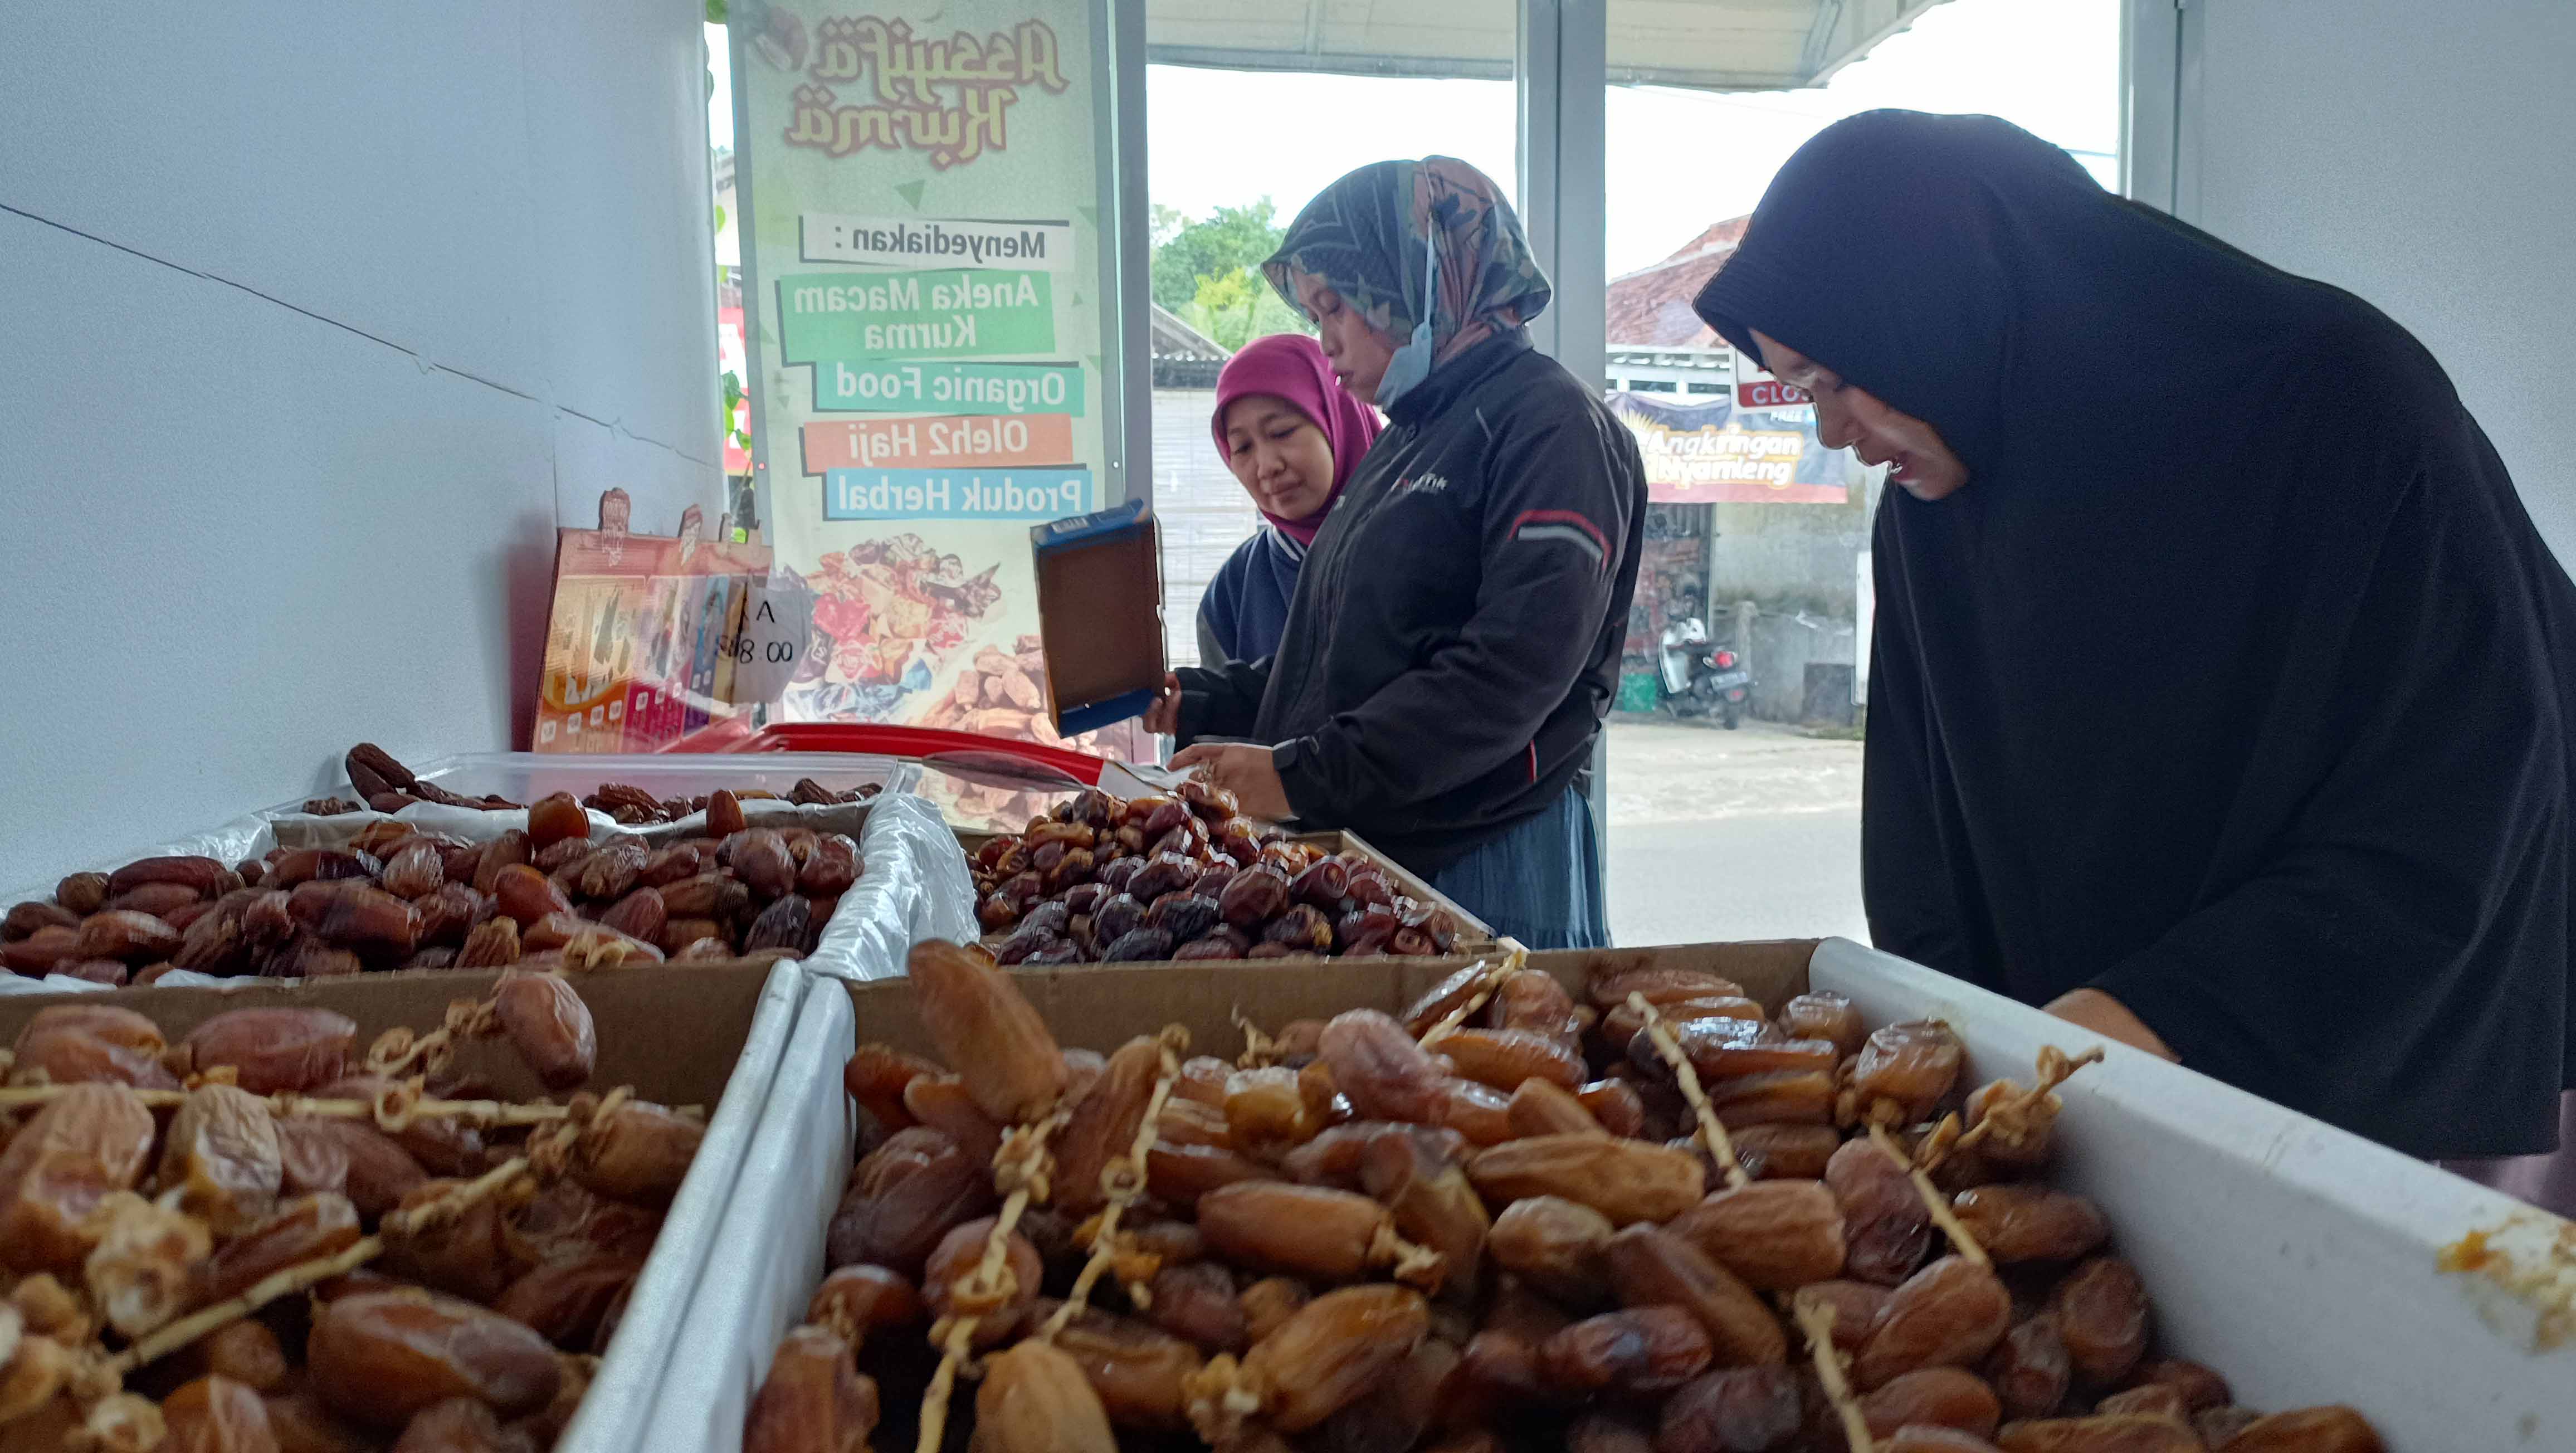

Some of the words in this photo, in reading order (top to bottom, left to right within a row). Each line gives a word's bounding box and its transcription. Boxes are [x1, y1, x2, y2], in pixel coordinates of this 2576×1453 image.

[1752, 383, 1809, 404] CLO
[1647, 427, 1800, 458] Angkringan
[1657, 455, 1793, 487] Nyamleng
